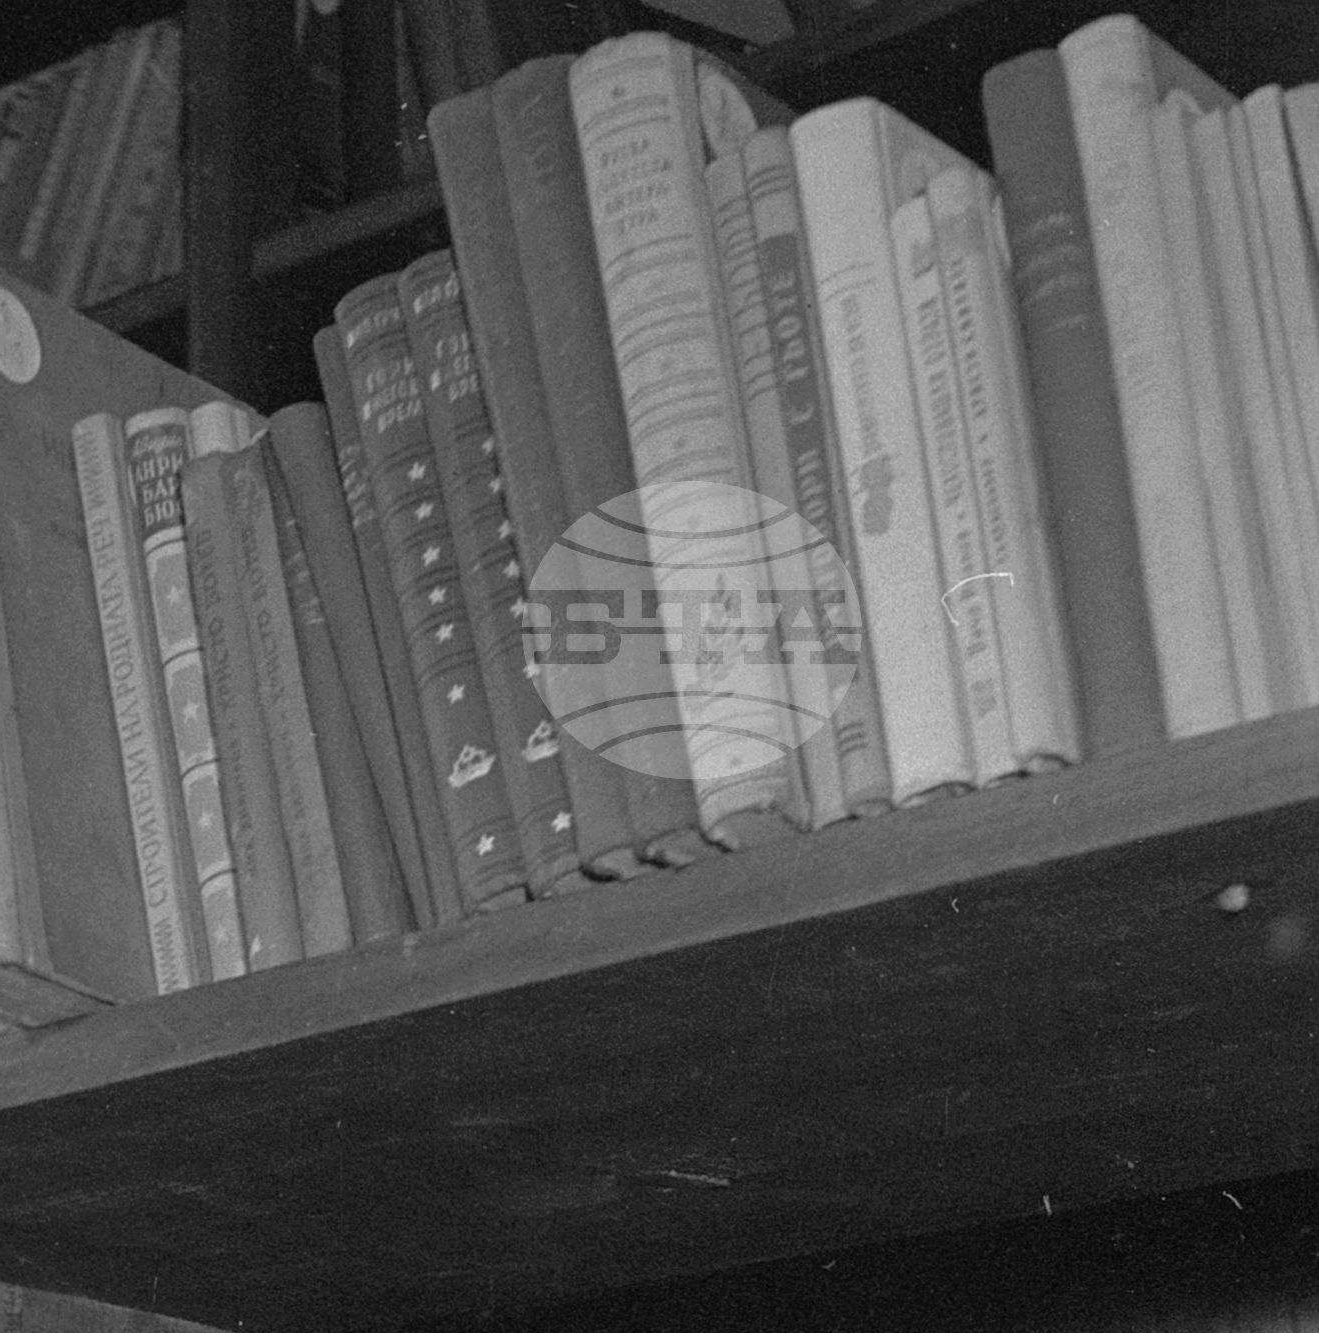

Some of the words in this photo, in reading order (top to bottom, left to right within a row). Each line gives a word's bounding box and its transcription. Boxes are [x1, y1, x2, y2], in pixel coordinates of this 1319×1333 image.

[90, 518, 117, 570] РЕЧ
[100, 573, 137, 696] РОДНАТА
[118, 697, 144, 738] НА
[126, 745, 165, 906] СТРОИТЕЛИ
